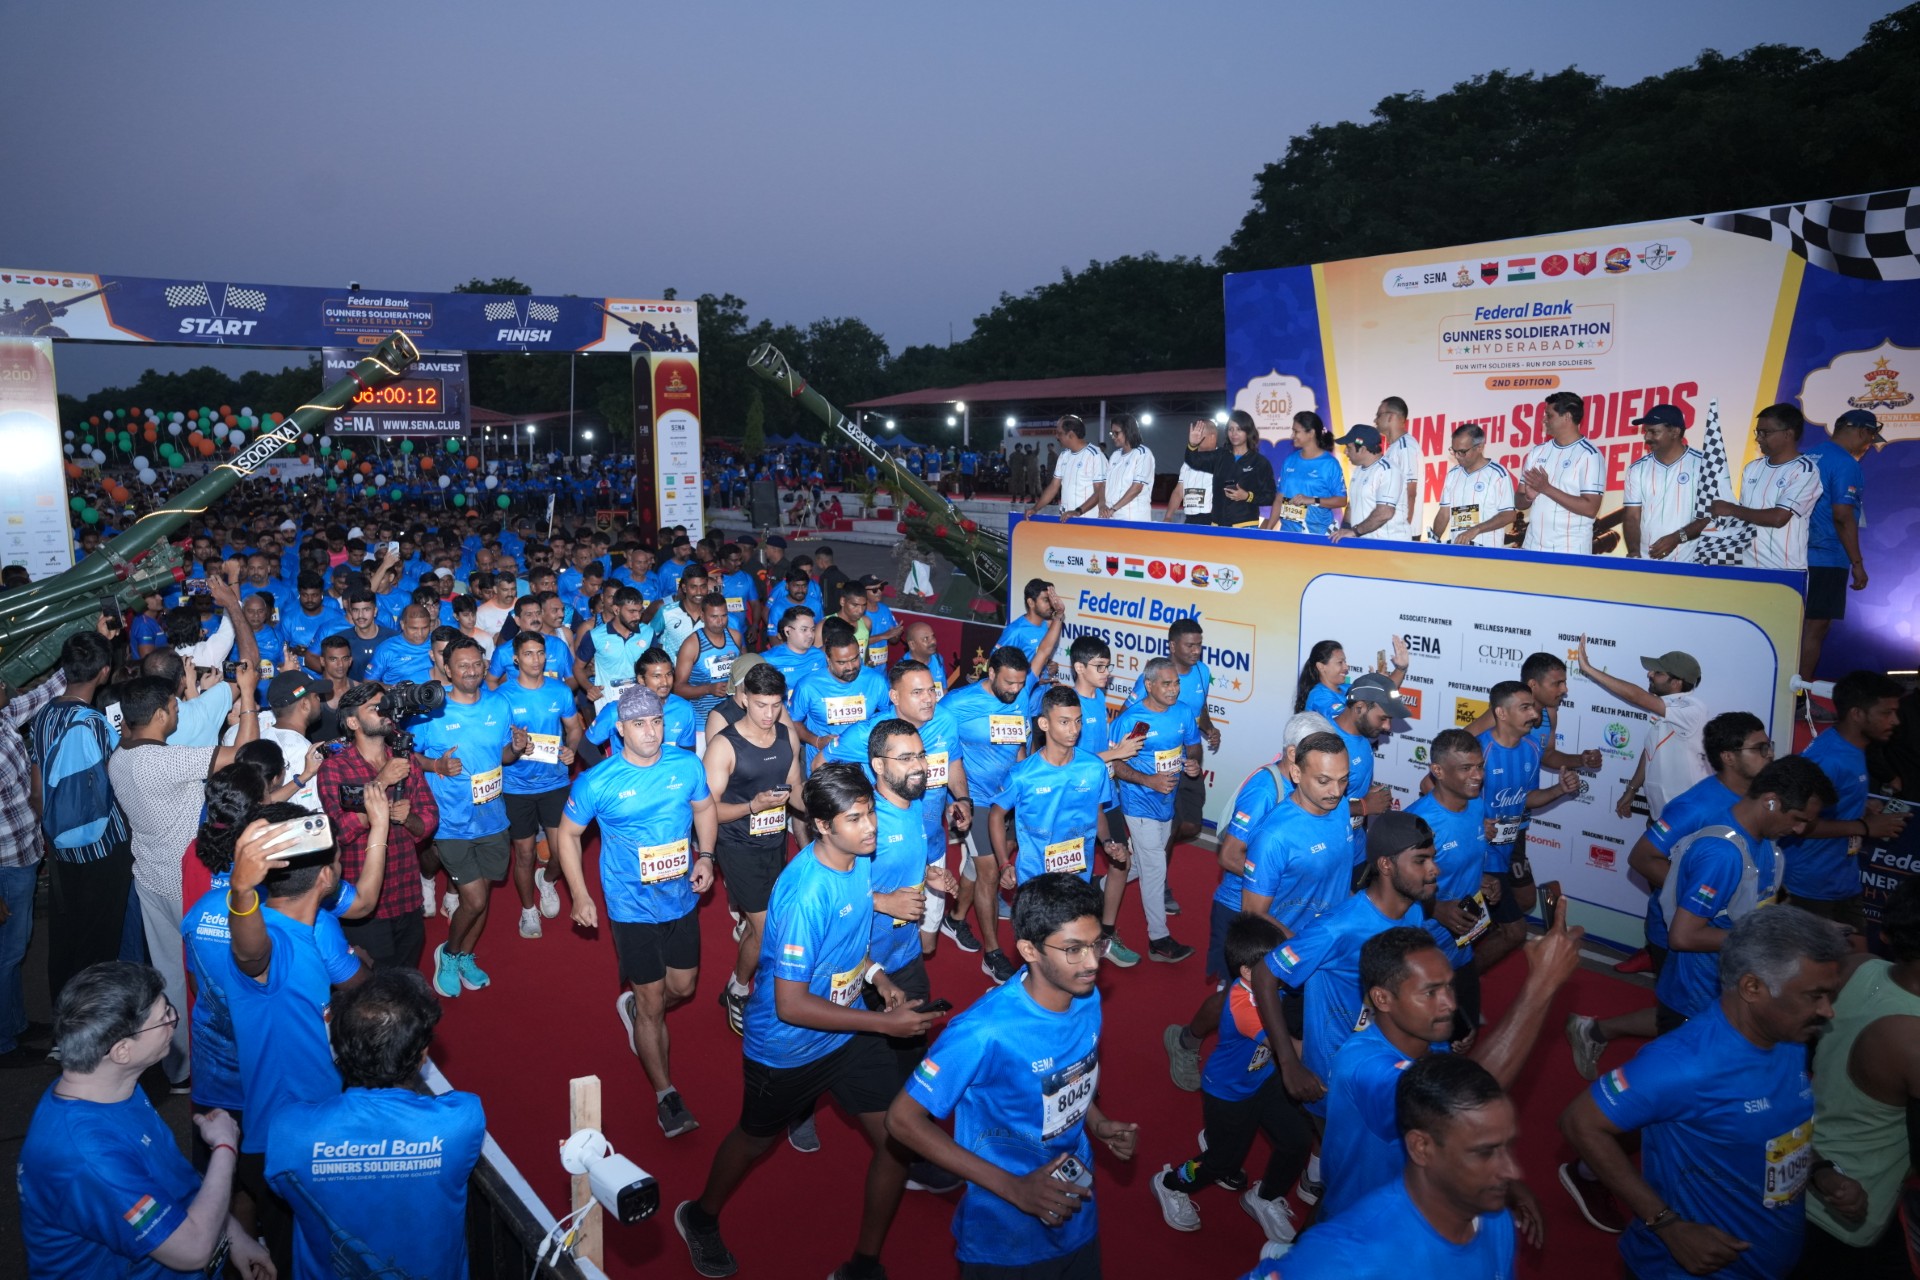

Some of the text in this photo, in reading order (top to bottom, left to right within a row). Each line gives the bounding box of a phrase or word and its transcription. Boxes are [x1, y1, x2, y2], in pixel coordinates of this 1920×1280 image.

[1424, 271, 1447, 284] SENA
[348, 296, 410, 308] Federal Bank
[326, 309, 431, 320] GUNNERS SOLDIERATHON
[1474, 300, 1574, 321] Federal Bank
[178, 318, 258, 336] START
[347, 318, 412, 326] HYDERABAD
[497, 329, 552, 342] FINISH
[1442, 322, 1610, 343] GUNNERS SOLDIERATHON
[1472, 338, 1575, 354] HYDERABAD
[327, 360, 357, 369] MAD
[1492, 378, 1552, 387] 2ND EDITION
[1261, 400, 1286, 414] 200
[334, 416, 460, 432] SENA WWW.SENA.CLUB
[1068, 556, 1084, 566] SENA
[1078, 590, 1202, 624] Federal Bank
[1399, 614, 1452, 626] ASSOCIATE PARTNER
[1474, 623, 1531, 636] WELLNESS PARTNER
[1403, 634, 1441, 654] SENA
[1558, 633, 1616, 647] HOUSIN PARTNER
[1062, 623, 1110, 646] NNERS
[1114, 630, 1250, 672] SOLDIETHON
[1478, 645, 1523, 661] CUPID
[717, 663, 731, 671] 802
[1410, 675, 1434, 684] PARTNER
[1448, 682, 1491, 694] PROTEIN PARTN
[833, 707, 863, 716] 11399
[1592, 705, 1648, 721] HEALTH PARTNER
[996, 727, 1023, 736] 11393
[618, 789, 637, 799] SENA
[756, 814, 784, 826] 11048
[1542, 820, 1561, 830] PARTNER
[1526, 834, 1561, 848] zoomin
[1582, 830, 1625, 845] SNACKING PARTNER
[1311, 842, 1326, 854] SENA
[1442, 840, 1458, 850] SENA
[649, 855, 686, 872] 10052
[1051, 852, 1082, 868] 10340
[1870, 848, 1920, 873] Fede
[200, 912, 228, 926] Feder
[196, 926, 224, 937] GUNNERS
[1032, 1057, 1053, 1073] SENA
[1058, 1078, 1091, 1112] 8045
[1744, 1098, 1770, 1114] SENA
[312, 1136, 444, 1158] Federal Bank
[312, 1158, 442, 1175] GUNNERS SOLDIERATHON
